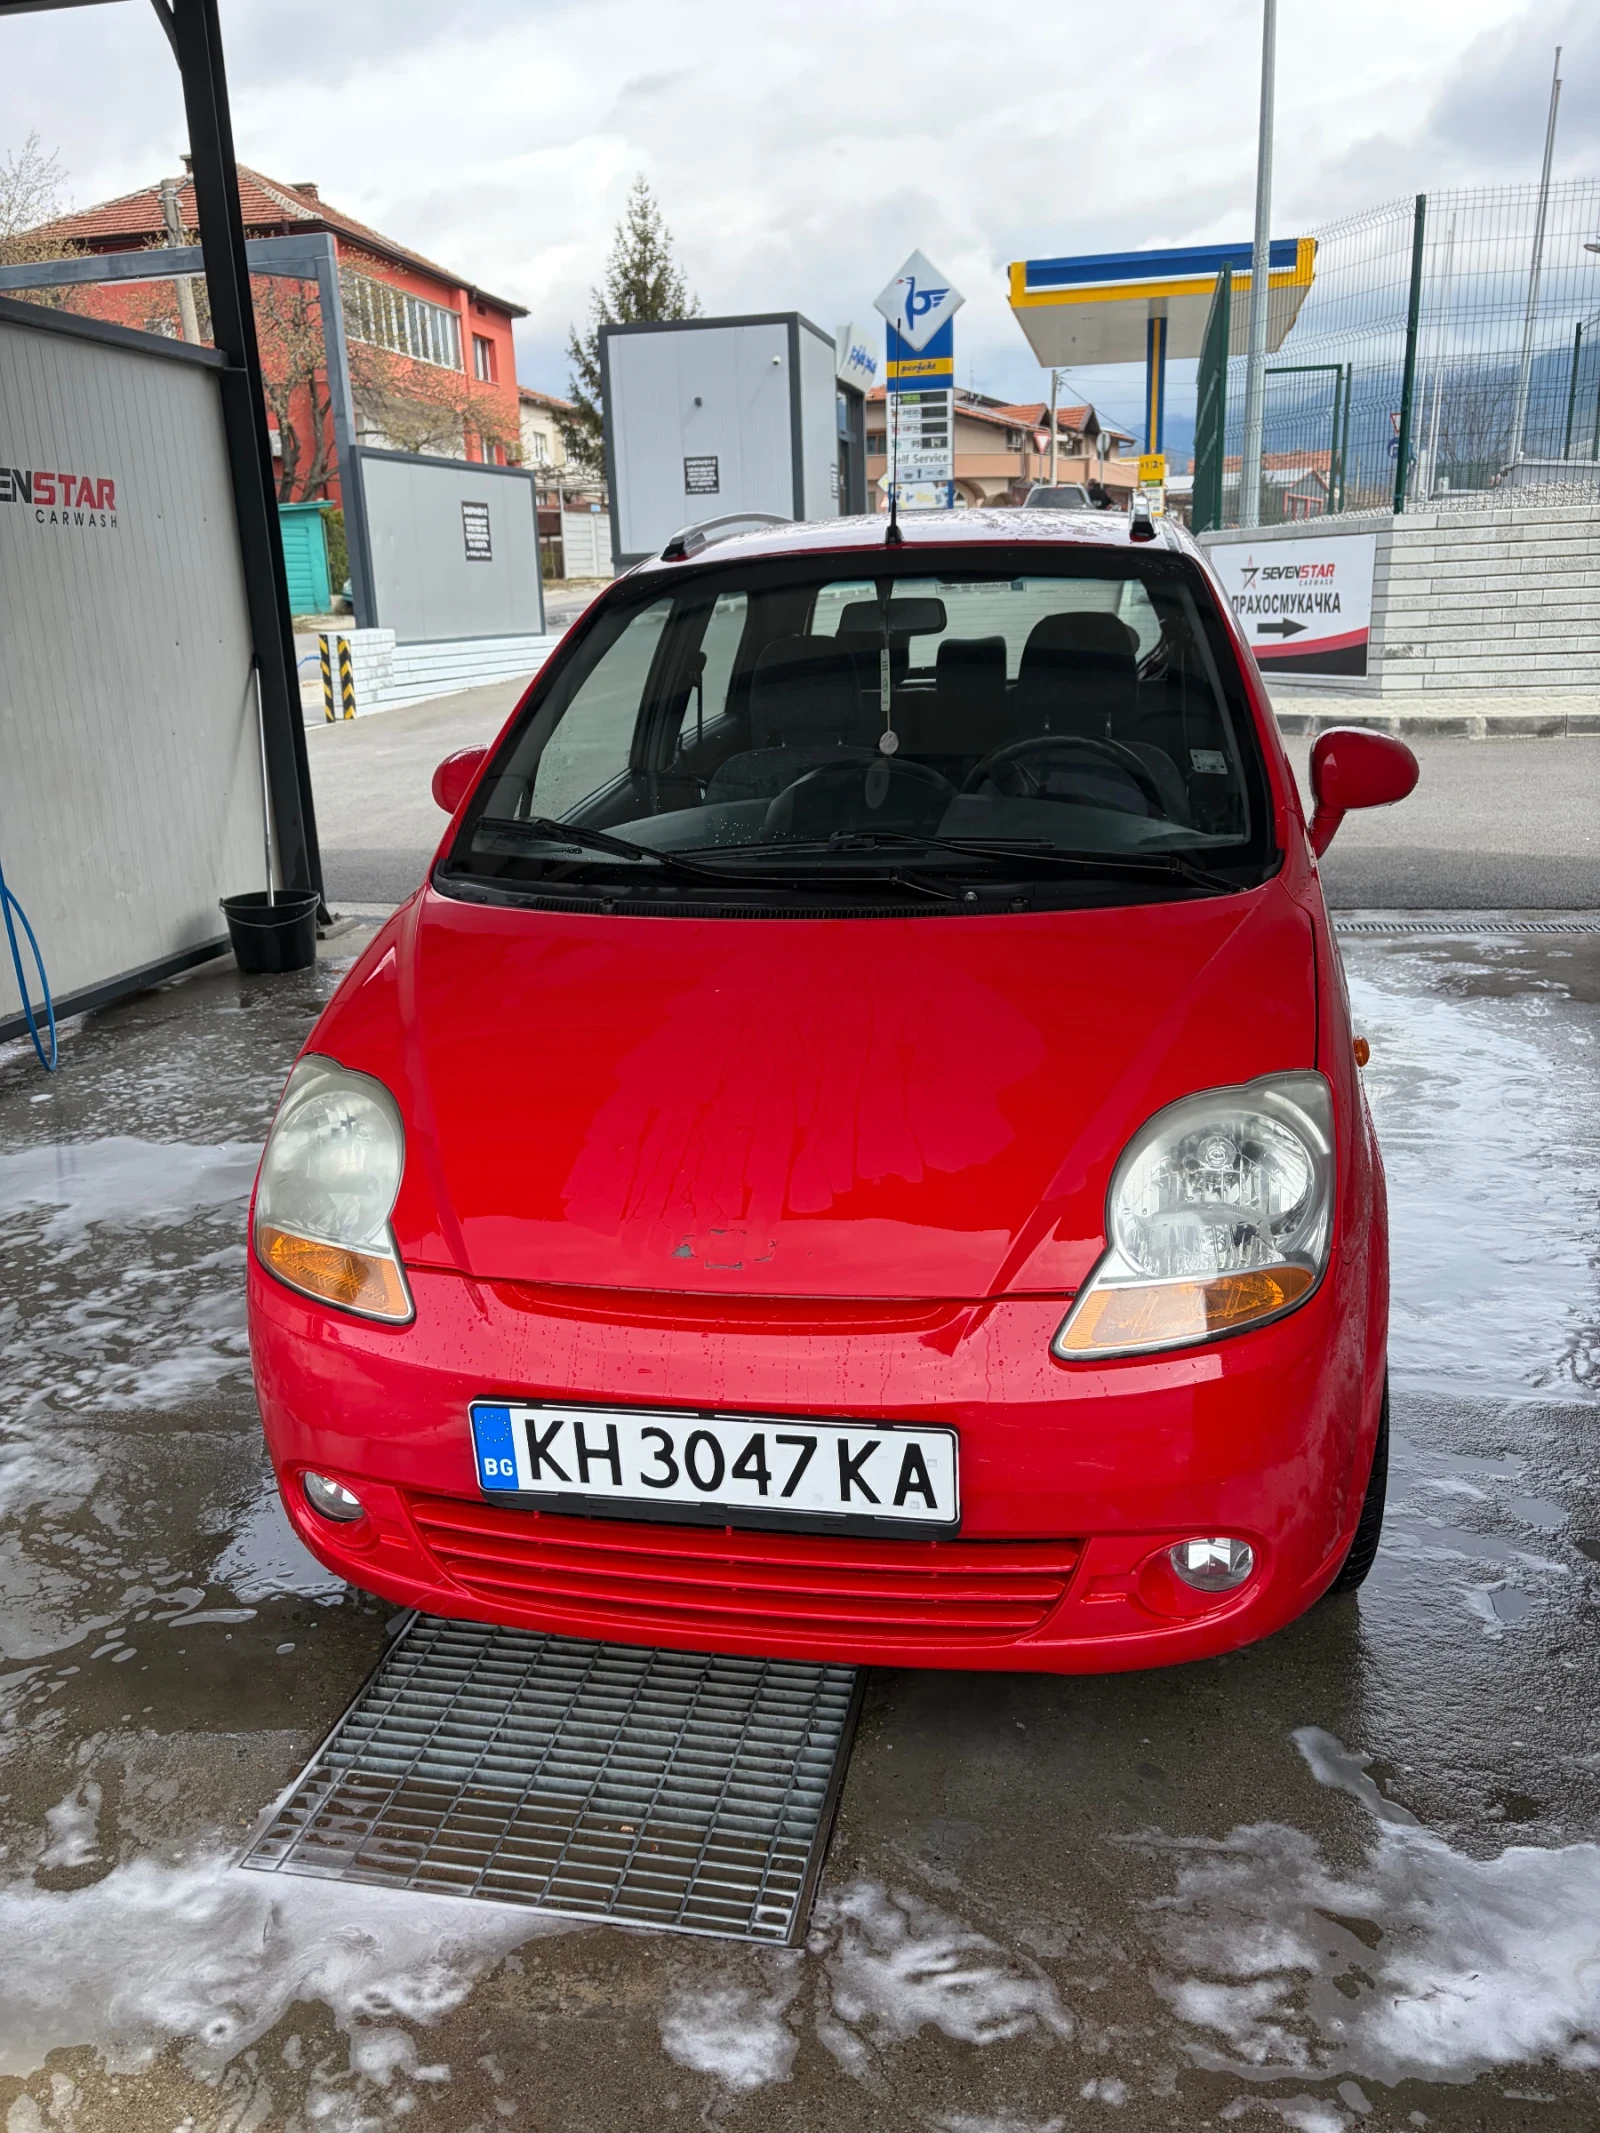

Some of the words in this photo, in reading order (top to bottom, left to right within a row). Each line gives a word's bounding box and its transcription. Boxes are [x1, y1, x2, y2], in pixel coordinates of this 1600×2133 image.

[913, 453, 948, 464] Service
[35, 509, 117, 528] CARWASH
[1261, 563, 1336, 581] SEVENSTAR
[1299, 579, 1334, 587] CARWASH
[1231, 592, 1341, 615] ПРАХОСМУКАЧКА
[484, 1458, 514, 1477] BG
[524, 1419, 623, 1486] KH
[640, 1426, 818, 1498] 3047
[837, 1438, 938, 1509] KA
